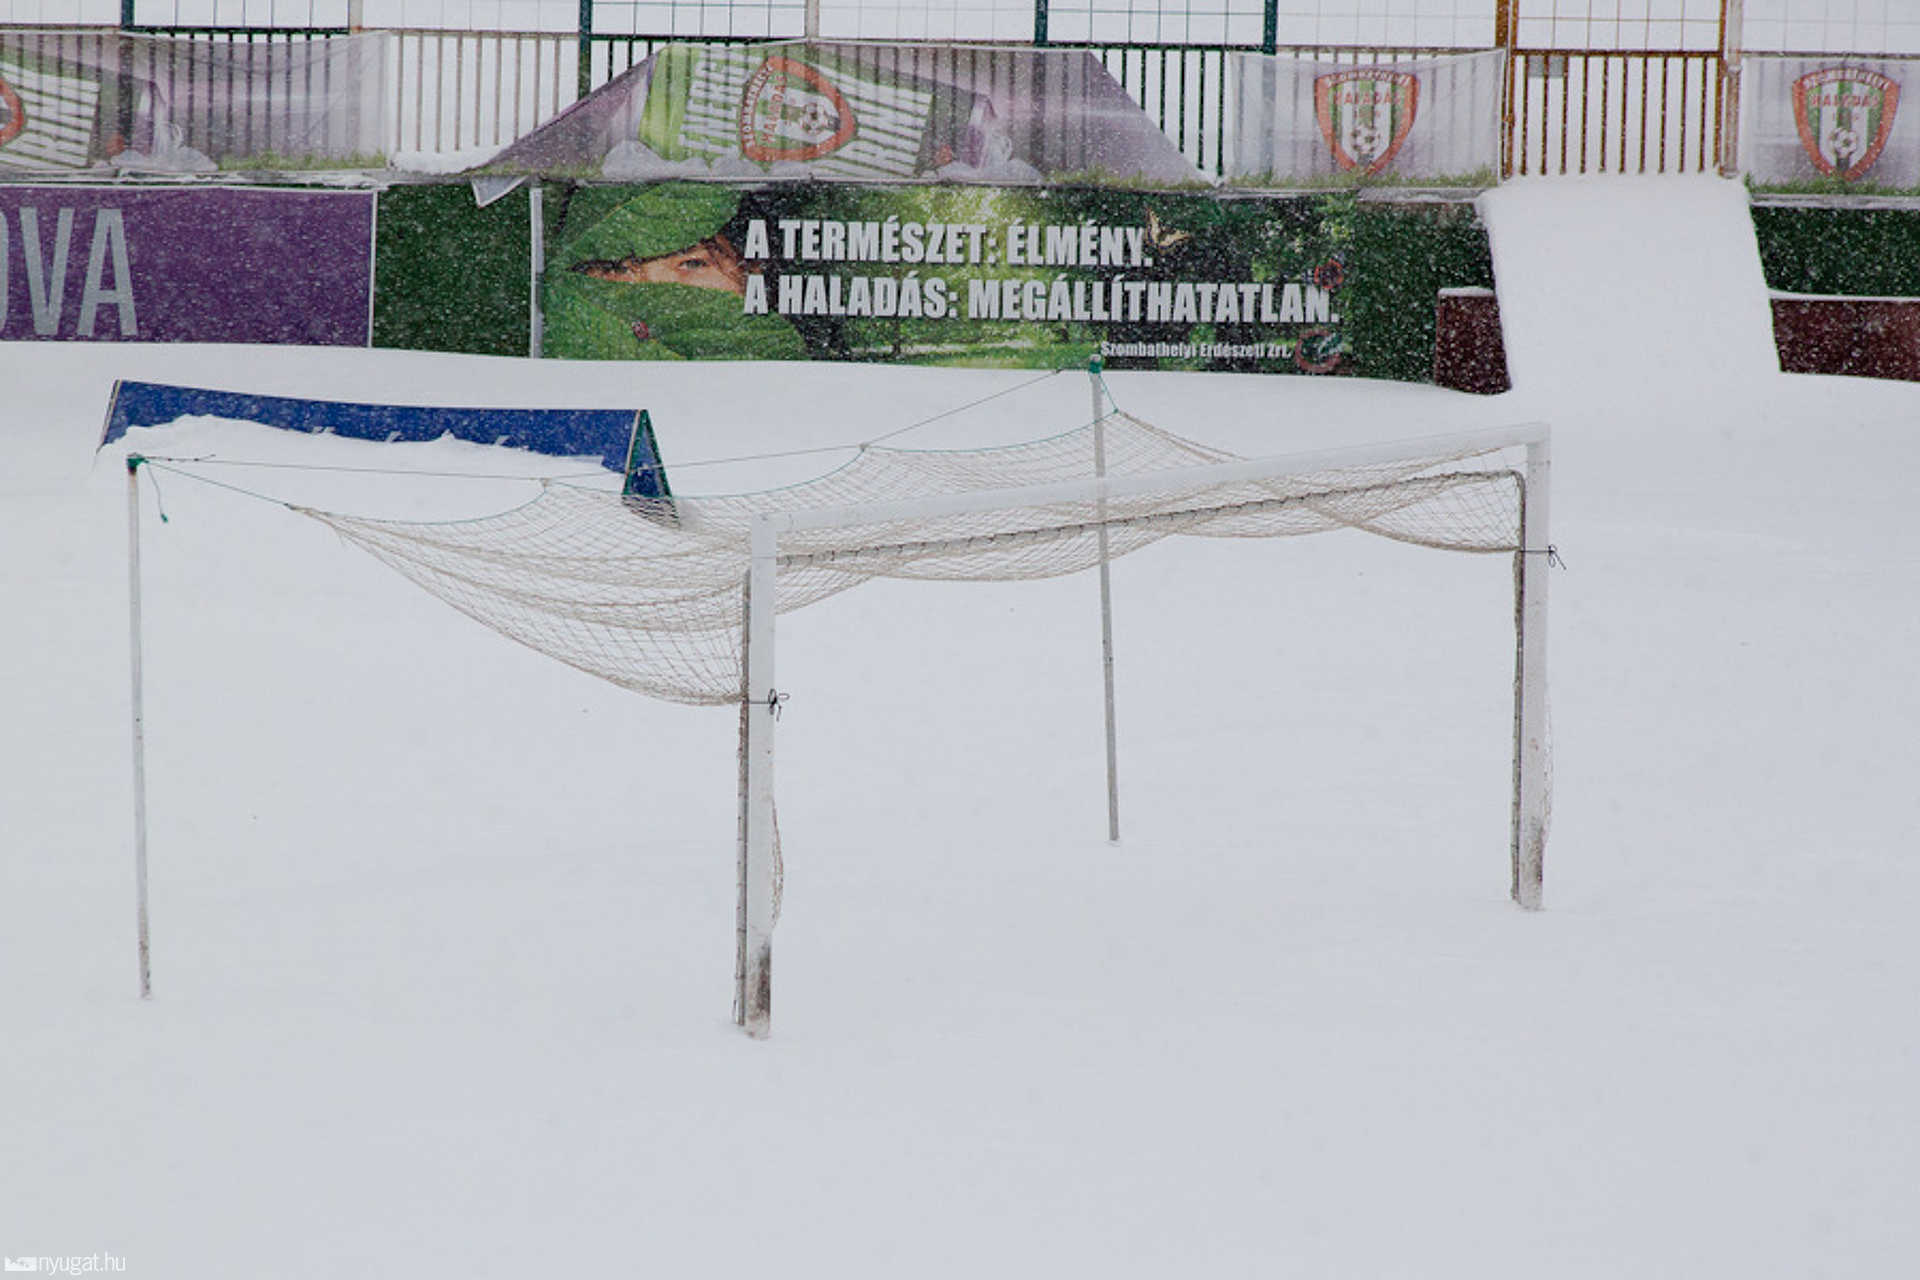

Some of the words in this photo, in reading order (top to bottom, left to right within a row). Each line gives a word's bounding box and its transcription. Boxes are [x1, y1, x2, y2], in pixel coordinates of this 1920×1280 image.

[744, 219, 769, 259] A
[778, 216, 998, 264] TERMÉSZET:
[1006, 217, 1153, 267] ÉLMÉNY.
[0, 207, 138, 336] VA
[744, 274, 769, 314] A
[778, 271, 959, 318] HALADÁS:
[967, 273, 1340, 323] MEGÁLLÍTHATATLAN.
[1100, 341, 1196, 359] Szombathelyi
[1199, 342, 1265, 358] Erdészeti
[1266, 344, 1292, 358] Zrt.
